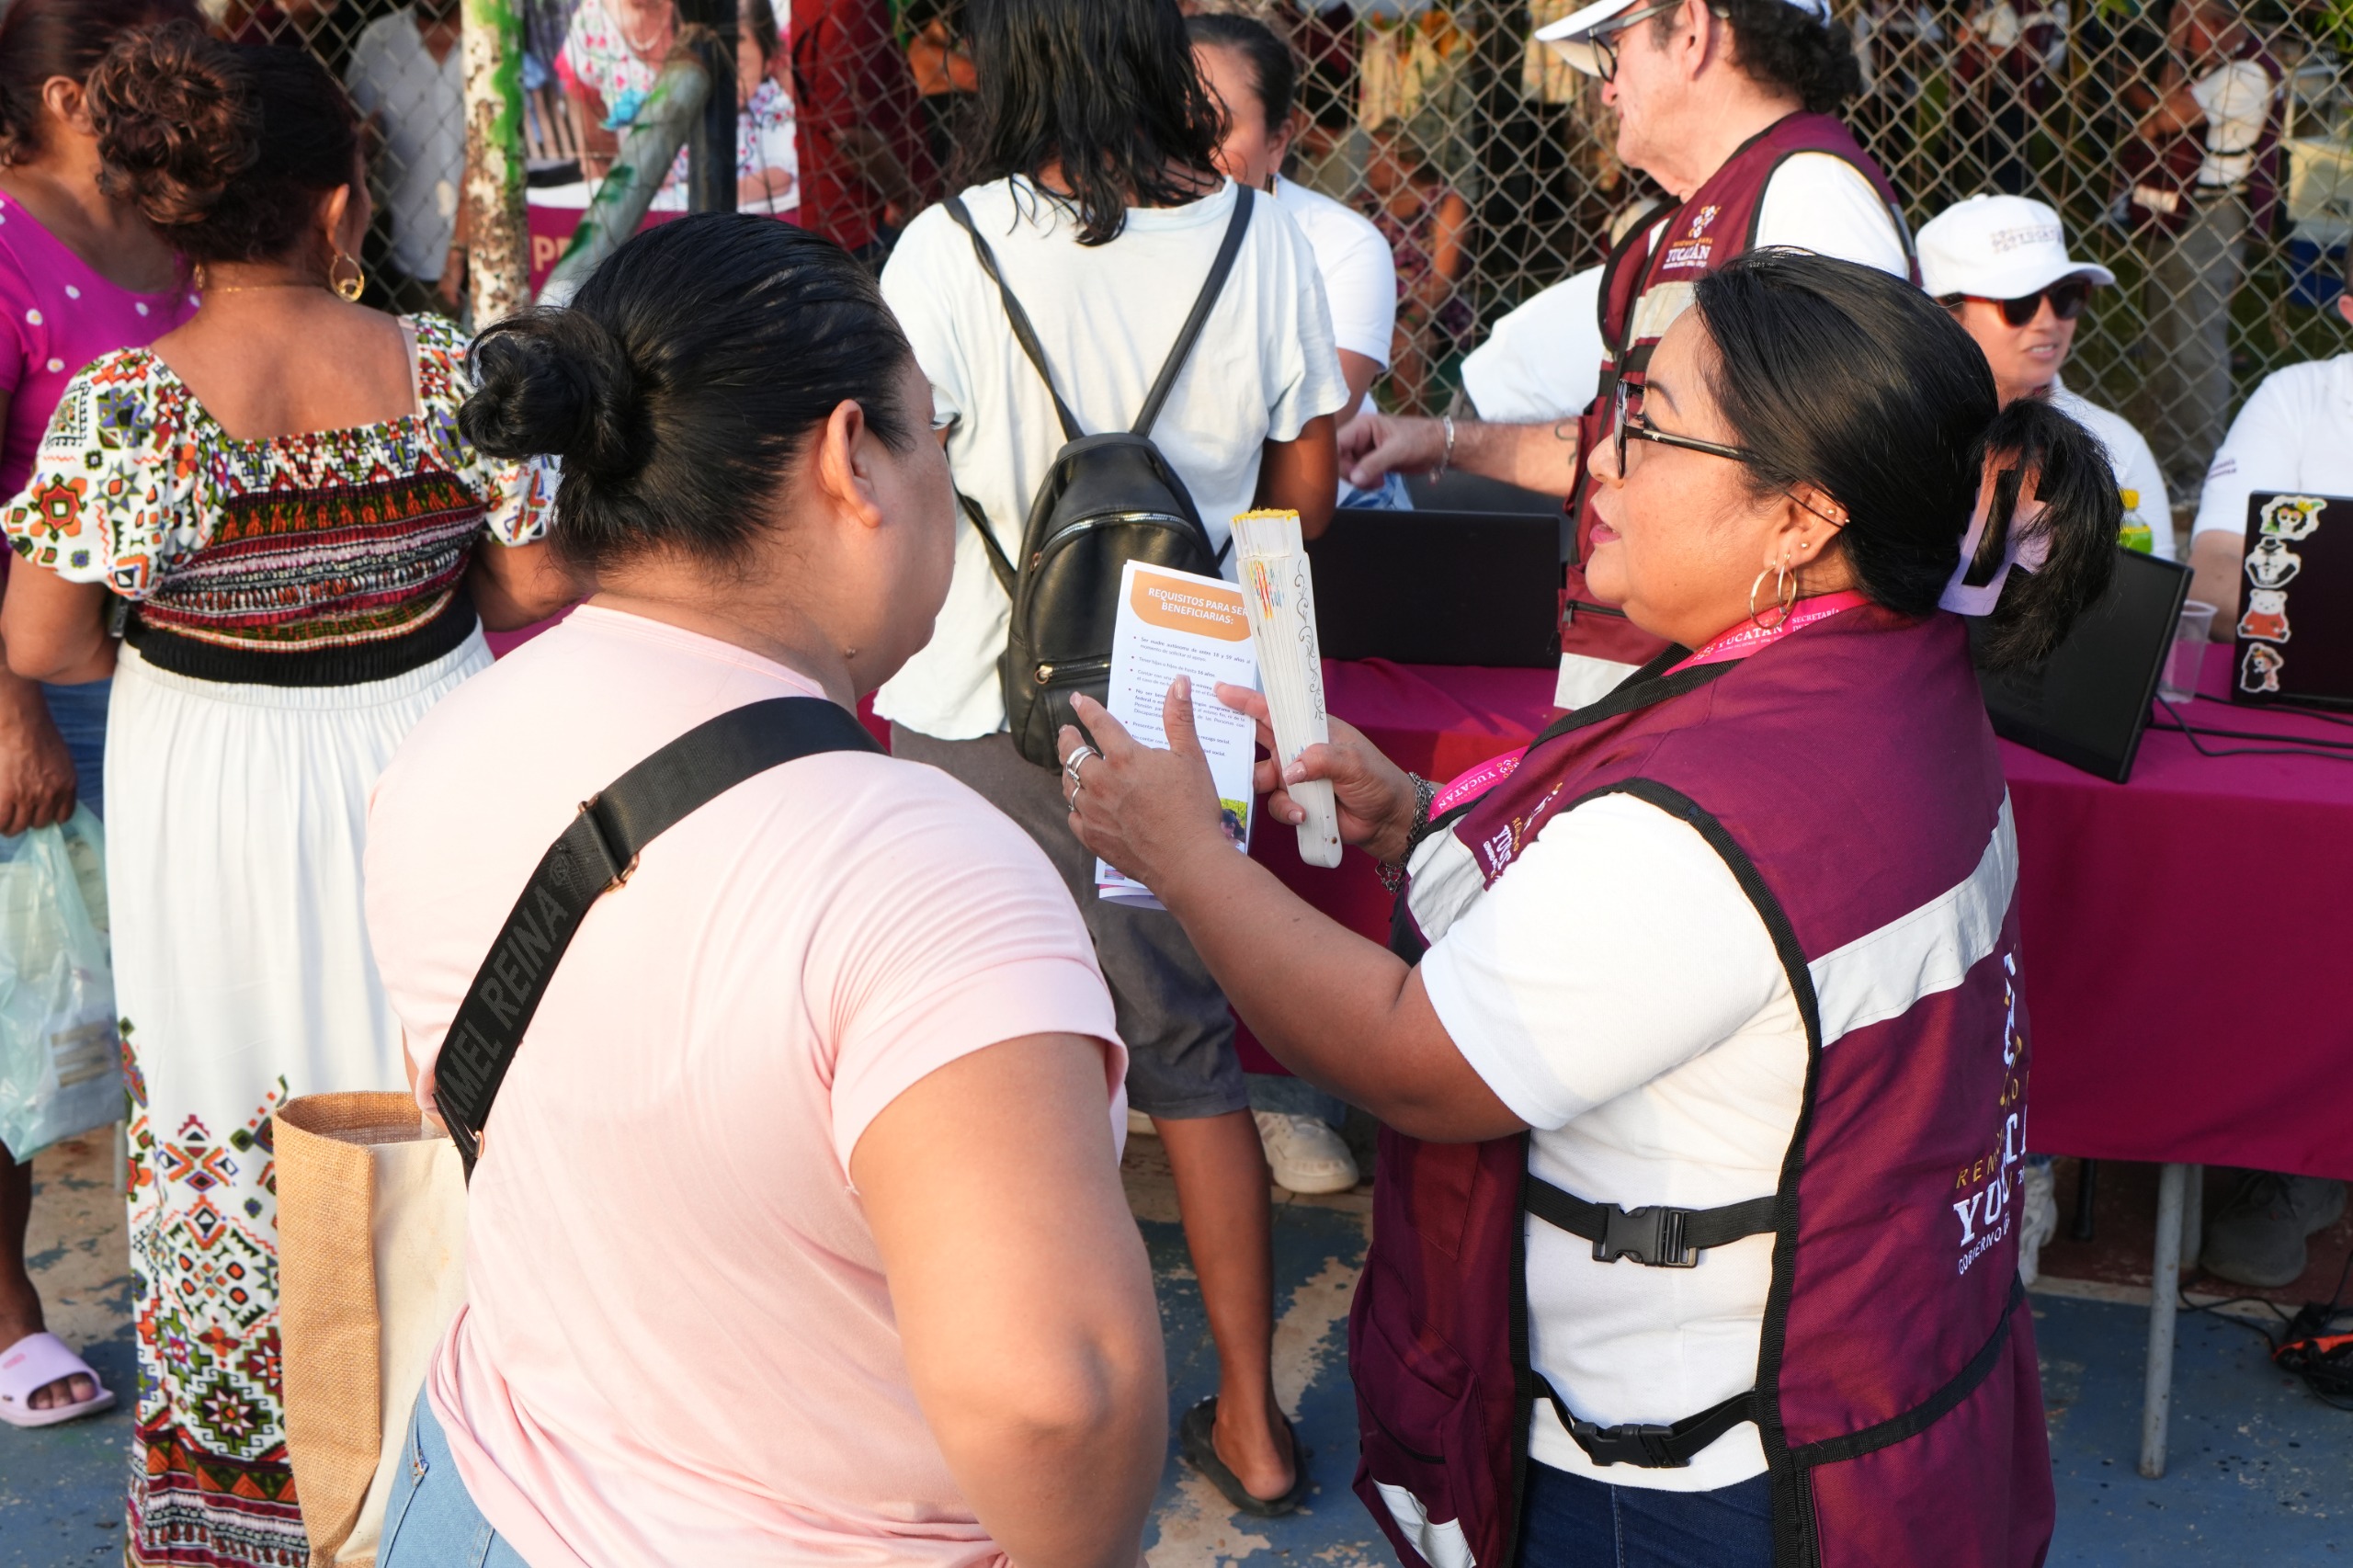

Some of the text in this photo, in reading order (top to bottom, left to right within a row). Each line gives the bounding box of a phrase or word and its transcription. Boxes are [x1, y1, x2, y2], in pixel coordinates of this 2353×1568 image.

[1148, 588, 1204, 607] REQUISITOS
[1206, 600, 1230, 612] PARA
[1161, 602, 1233, 624] BENEFICIARIAS:
[1439, 771, 1496, 809] YUCATÁN
[479, 884, 568, 1031] REINA
[1958, 1226, 2001, 1275] GOBIERNO
